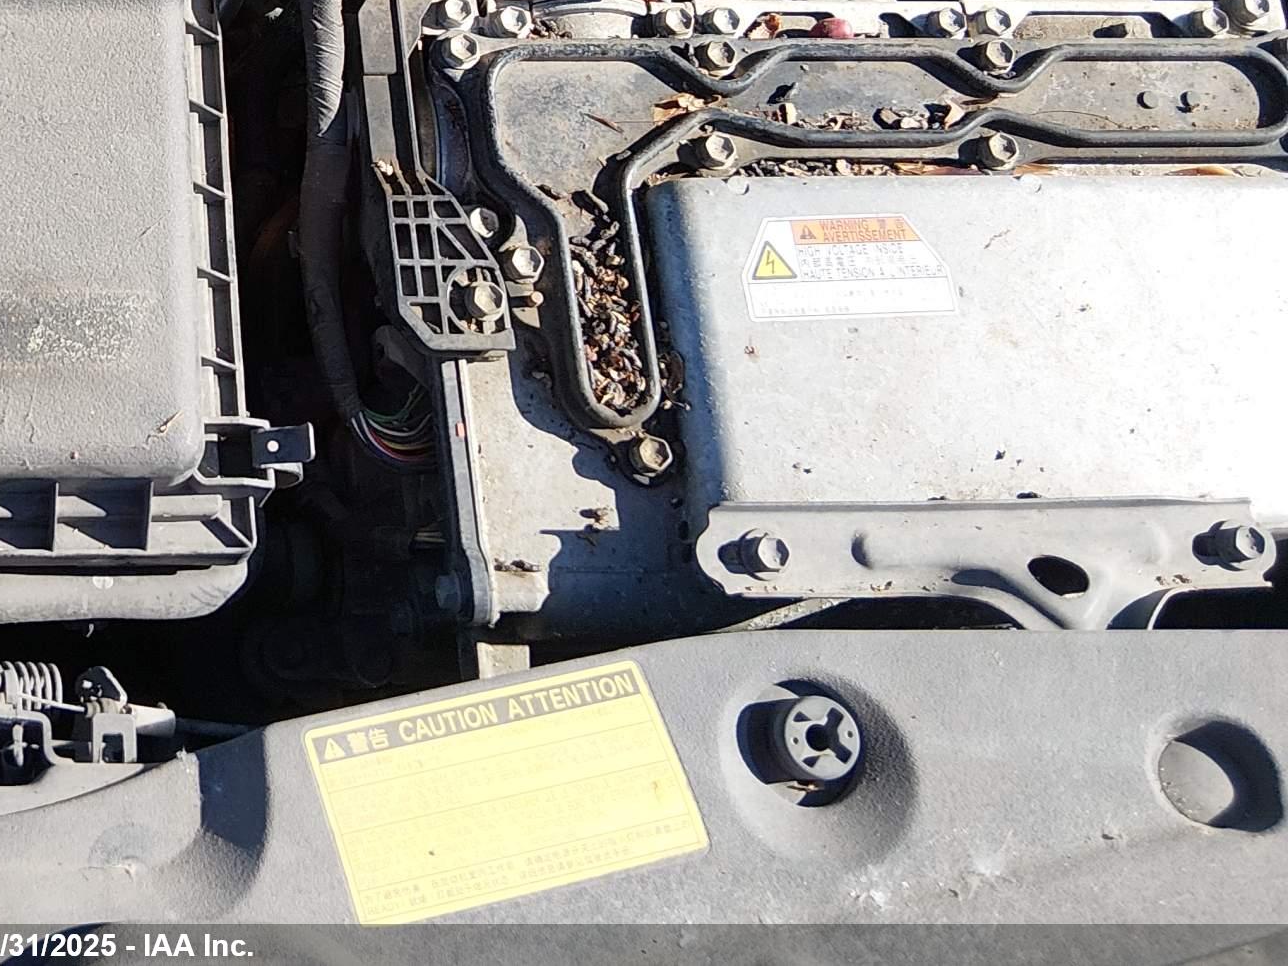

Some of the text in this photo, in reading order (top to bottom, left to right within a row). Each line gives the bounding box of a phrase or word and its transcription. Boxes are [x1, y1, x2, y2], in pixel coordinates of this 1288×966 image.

[819, 219, 869, 231] WARNING
[823, 229, 906, 242] AVERTISSEMENT
[347, 673, 634, 753] 警告 CAUTION ATTENTION
